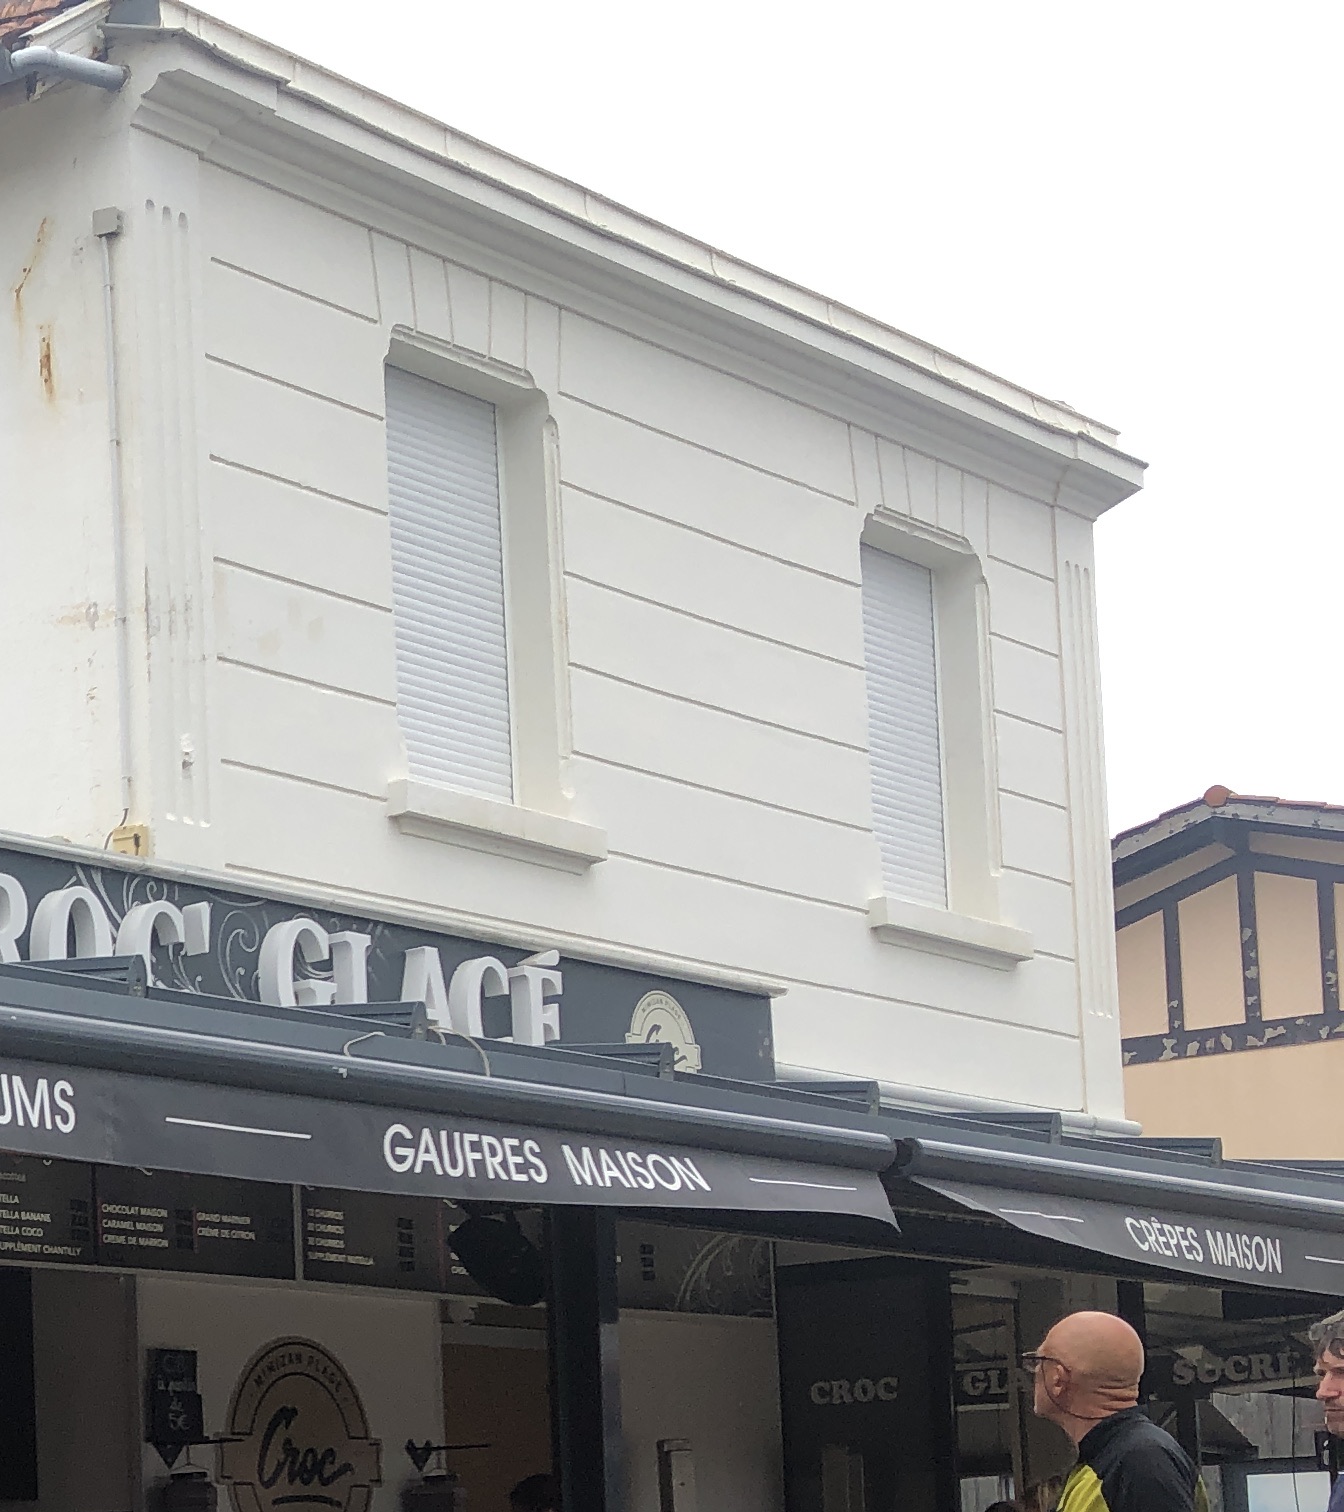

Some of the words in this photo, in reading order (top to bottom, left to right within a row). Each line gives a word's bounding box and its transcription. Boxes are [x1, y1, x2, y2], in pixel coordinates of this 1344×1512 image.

[384, 1123, 547, 1184] GAUFRES
[564, 1145, 711, 1192] MAISON
[101, 1203, 139, 1217] CHOCOLAT
[21, 1225, 44, 1238] COCO
[102, 1219, 135, 1231] CARAMEL
[1124, 1216, 1204, 1264] CRÊPES
[1209, 1230, 1283, 1275] MAISON
[810, 1376, 899, 1405] CROC
[257, 1405, 354, 1489] Croc
